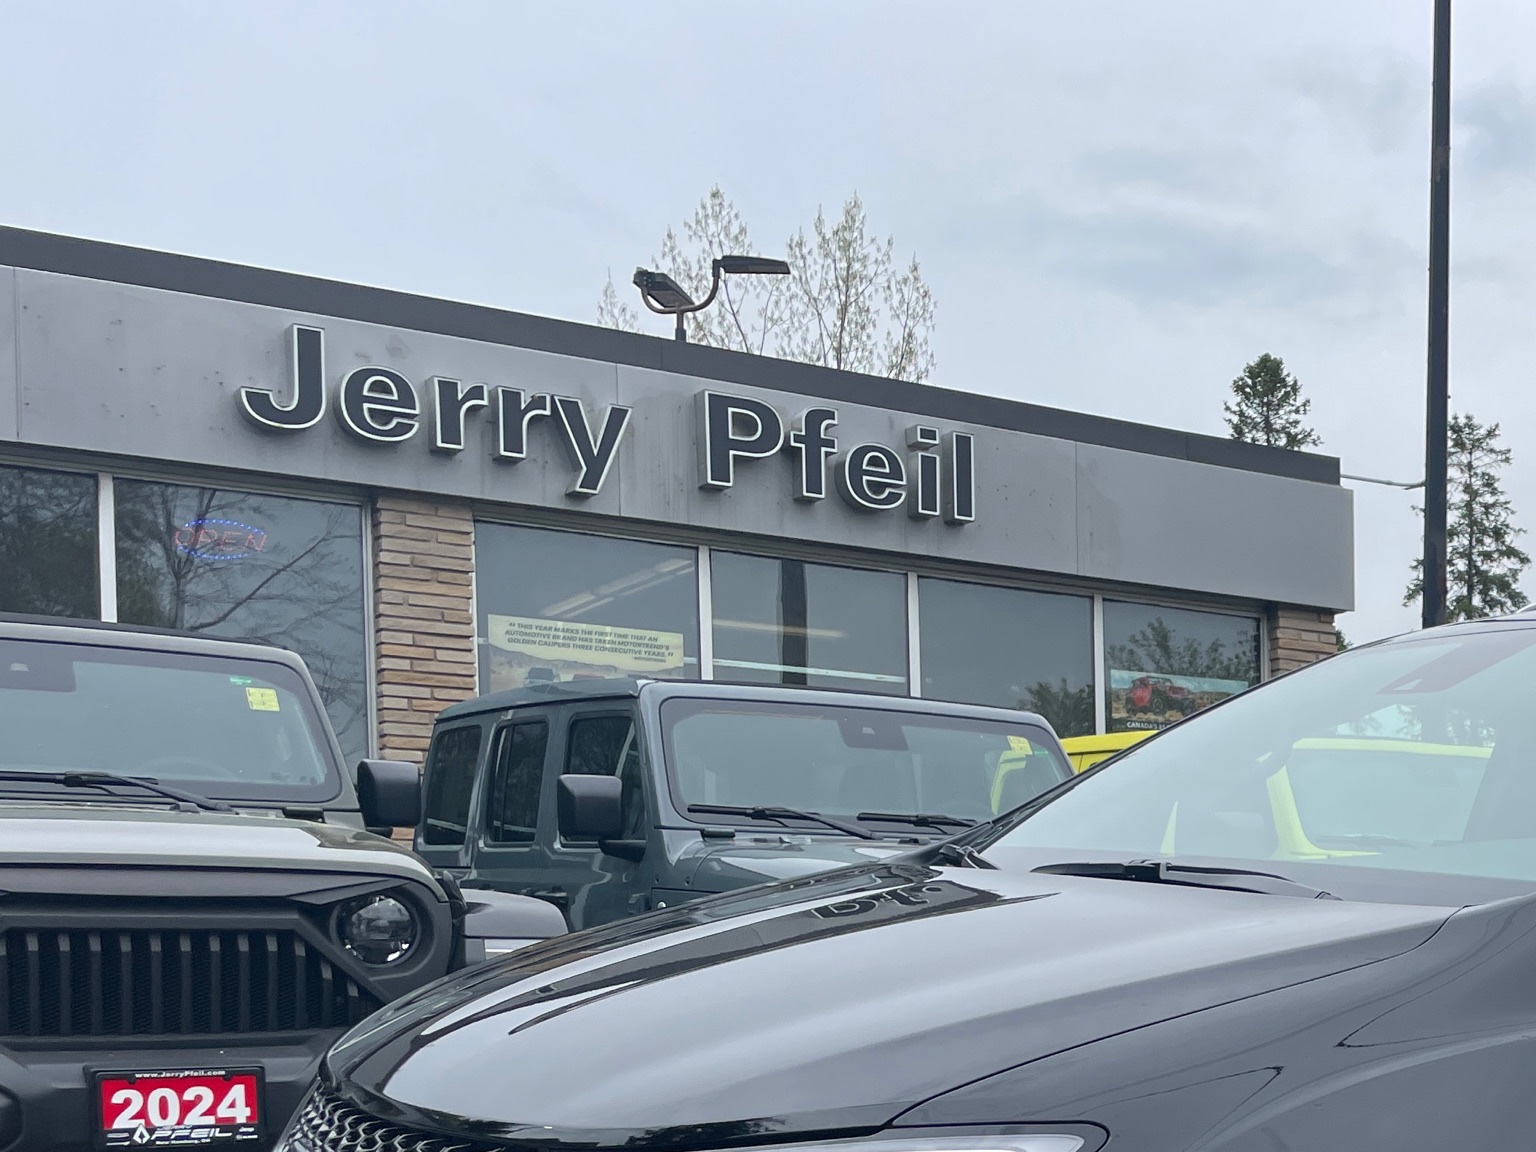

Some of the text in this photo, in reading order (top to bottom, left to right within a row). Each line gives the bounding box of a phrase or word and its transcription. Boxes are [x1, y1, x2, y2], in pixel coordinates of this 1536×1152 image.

[239, 324, 977, 525] Jerry Pfeil
[175, 528, 267, 552] OPEN
[505, 629, 551, 640] AUTOMOTIVE
[552, 633, 577, 642] BRAND
[594, 638, 617, 646] TAKEN
[535, 624, 553, 632] YEAR
[554, 626, 579, 635] MARKS
[507, 637, 536, 645] GOLDEN
[537, 640, 571, 649] CALIPERS
[572, 643, 593, 651] THREE
[594, 646, 643, 656] CONSECUTIVE
[1126, 721, 1157, 730] CANADA'S
[111, 1084, 251, 1130] 2024
[150, 1127, 233, 1141] PFEIL
